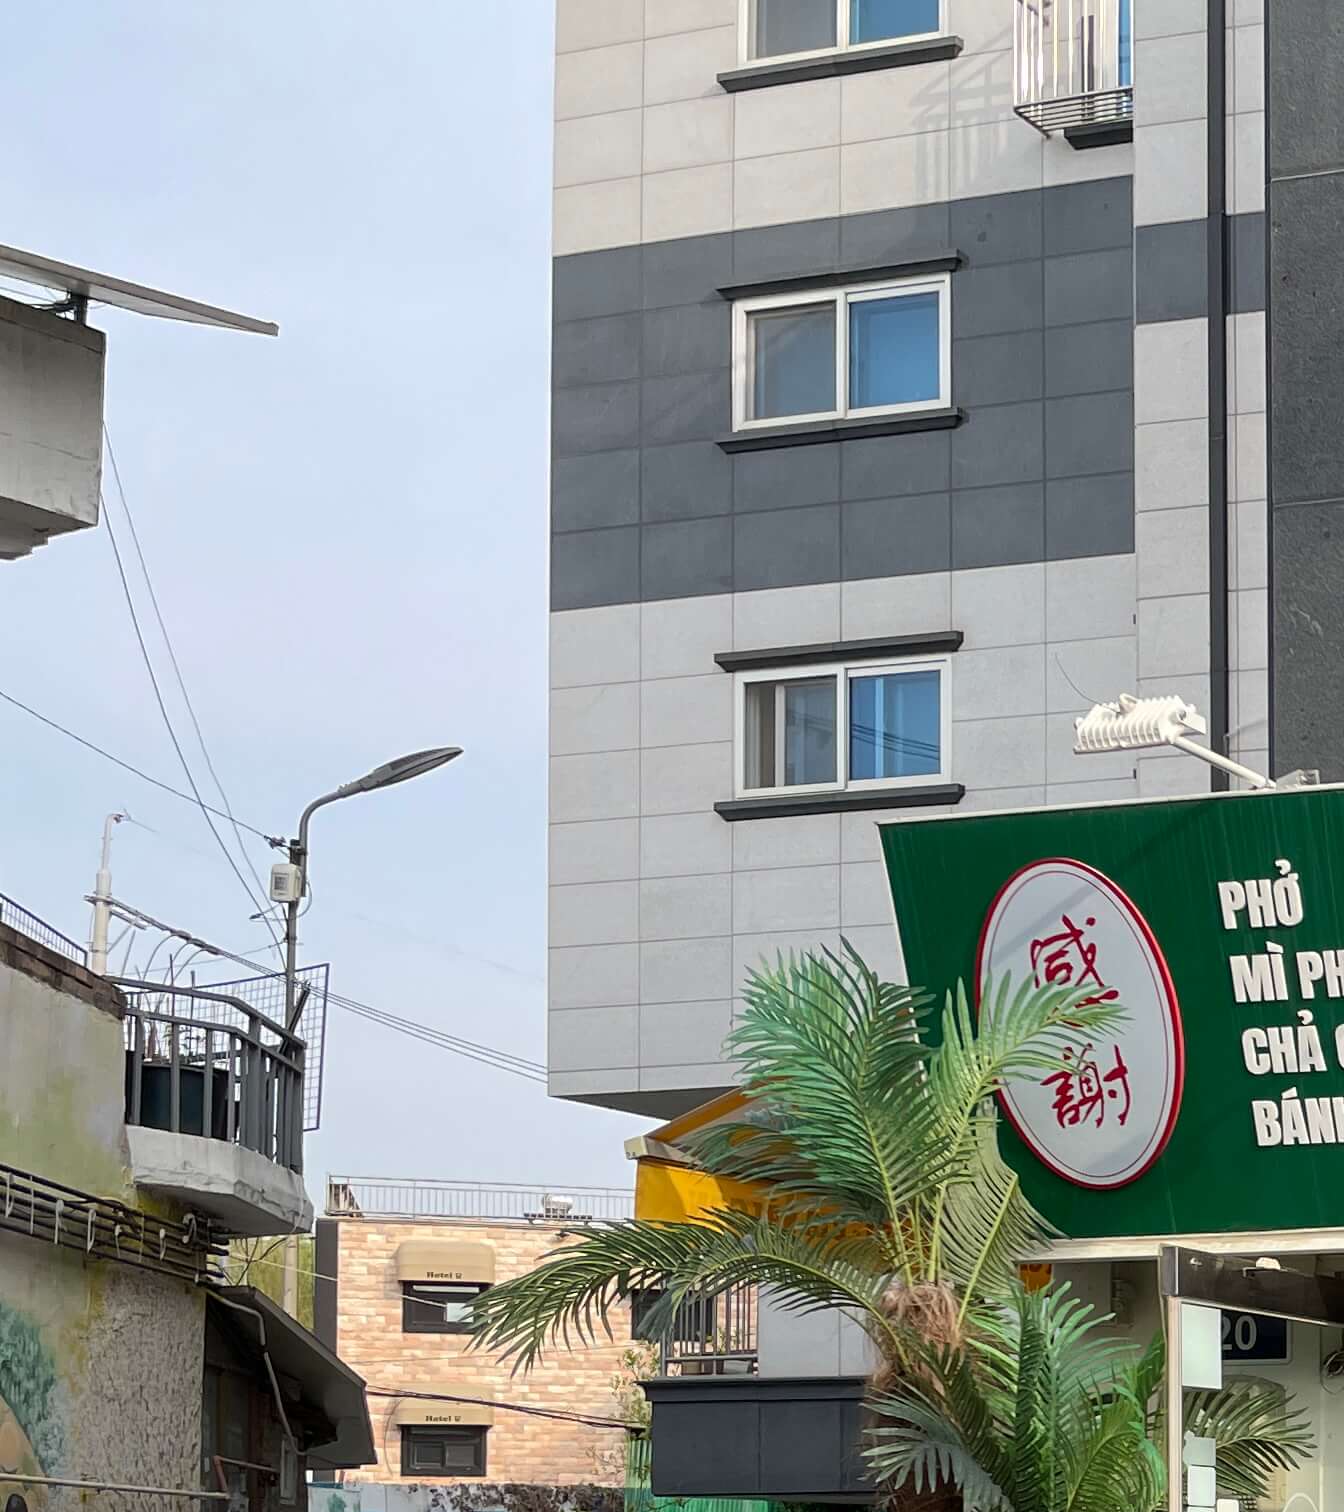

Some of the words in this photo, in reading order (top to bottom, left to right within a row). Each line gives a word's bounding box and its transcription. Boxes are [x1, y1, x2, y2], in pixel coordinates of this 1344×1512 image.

[1217, 859, 1303, 930] PHỞ
[1229, 941, 1290, 1003] MÌ
[1240, 1009, 1328, 1076] CHẢ
